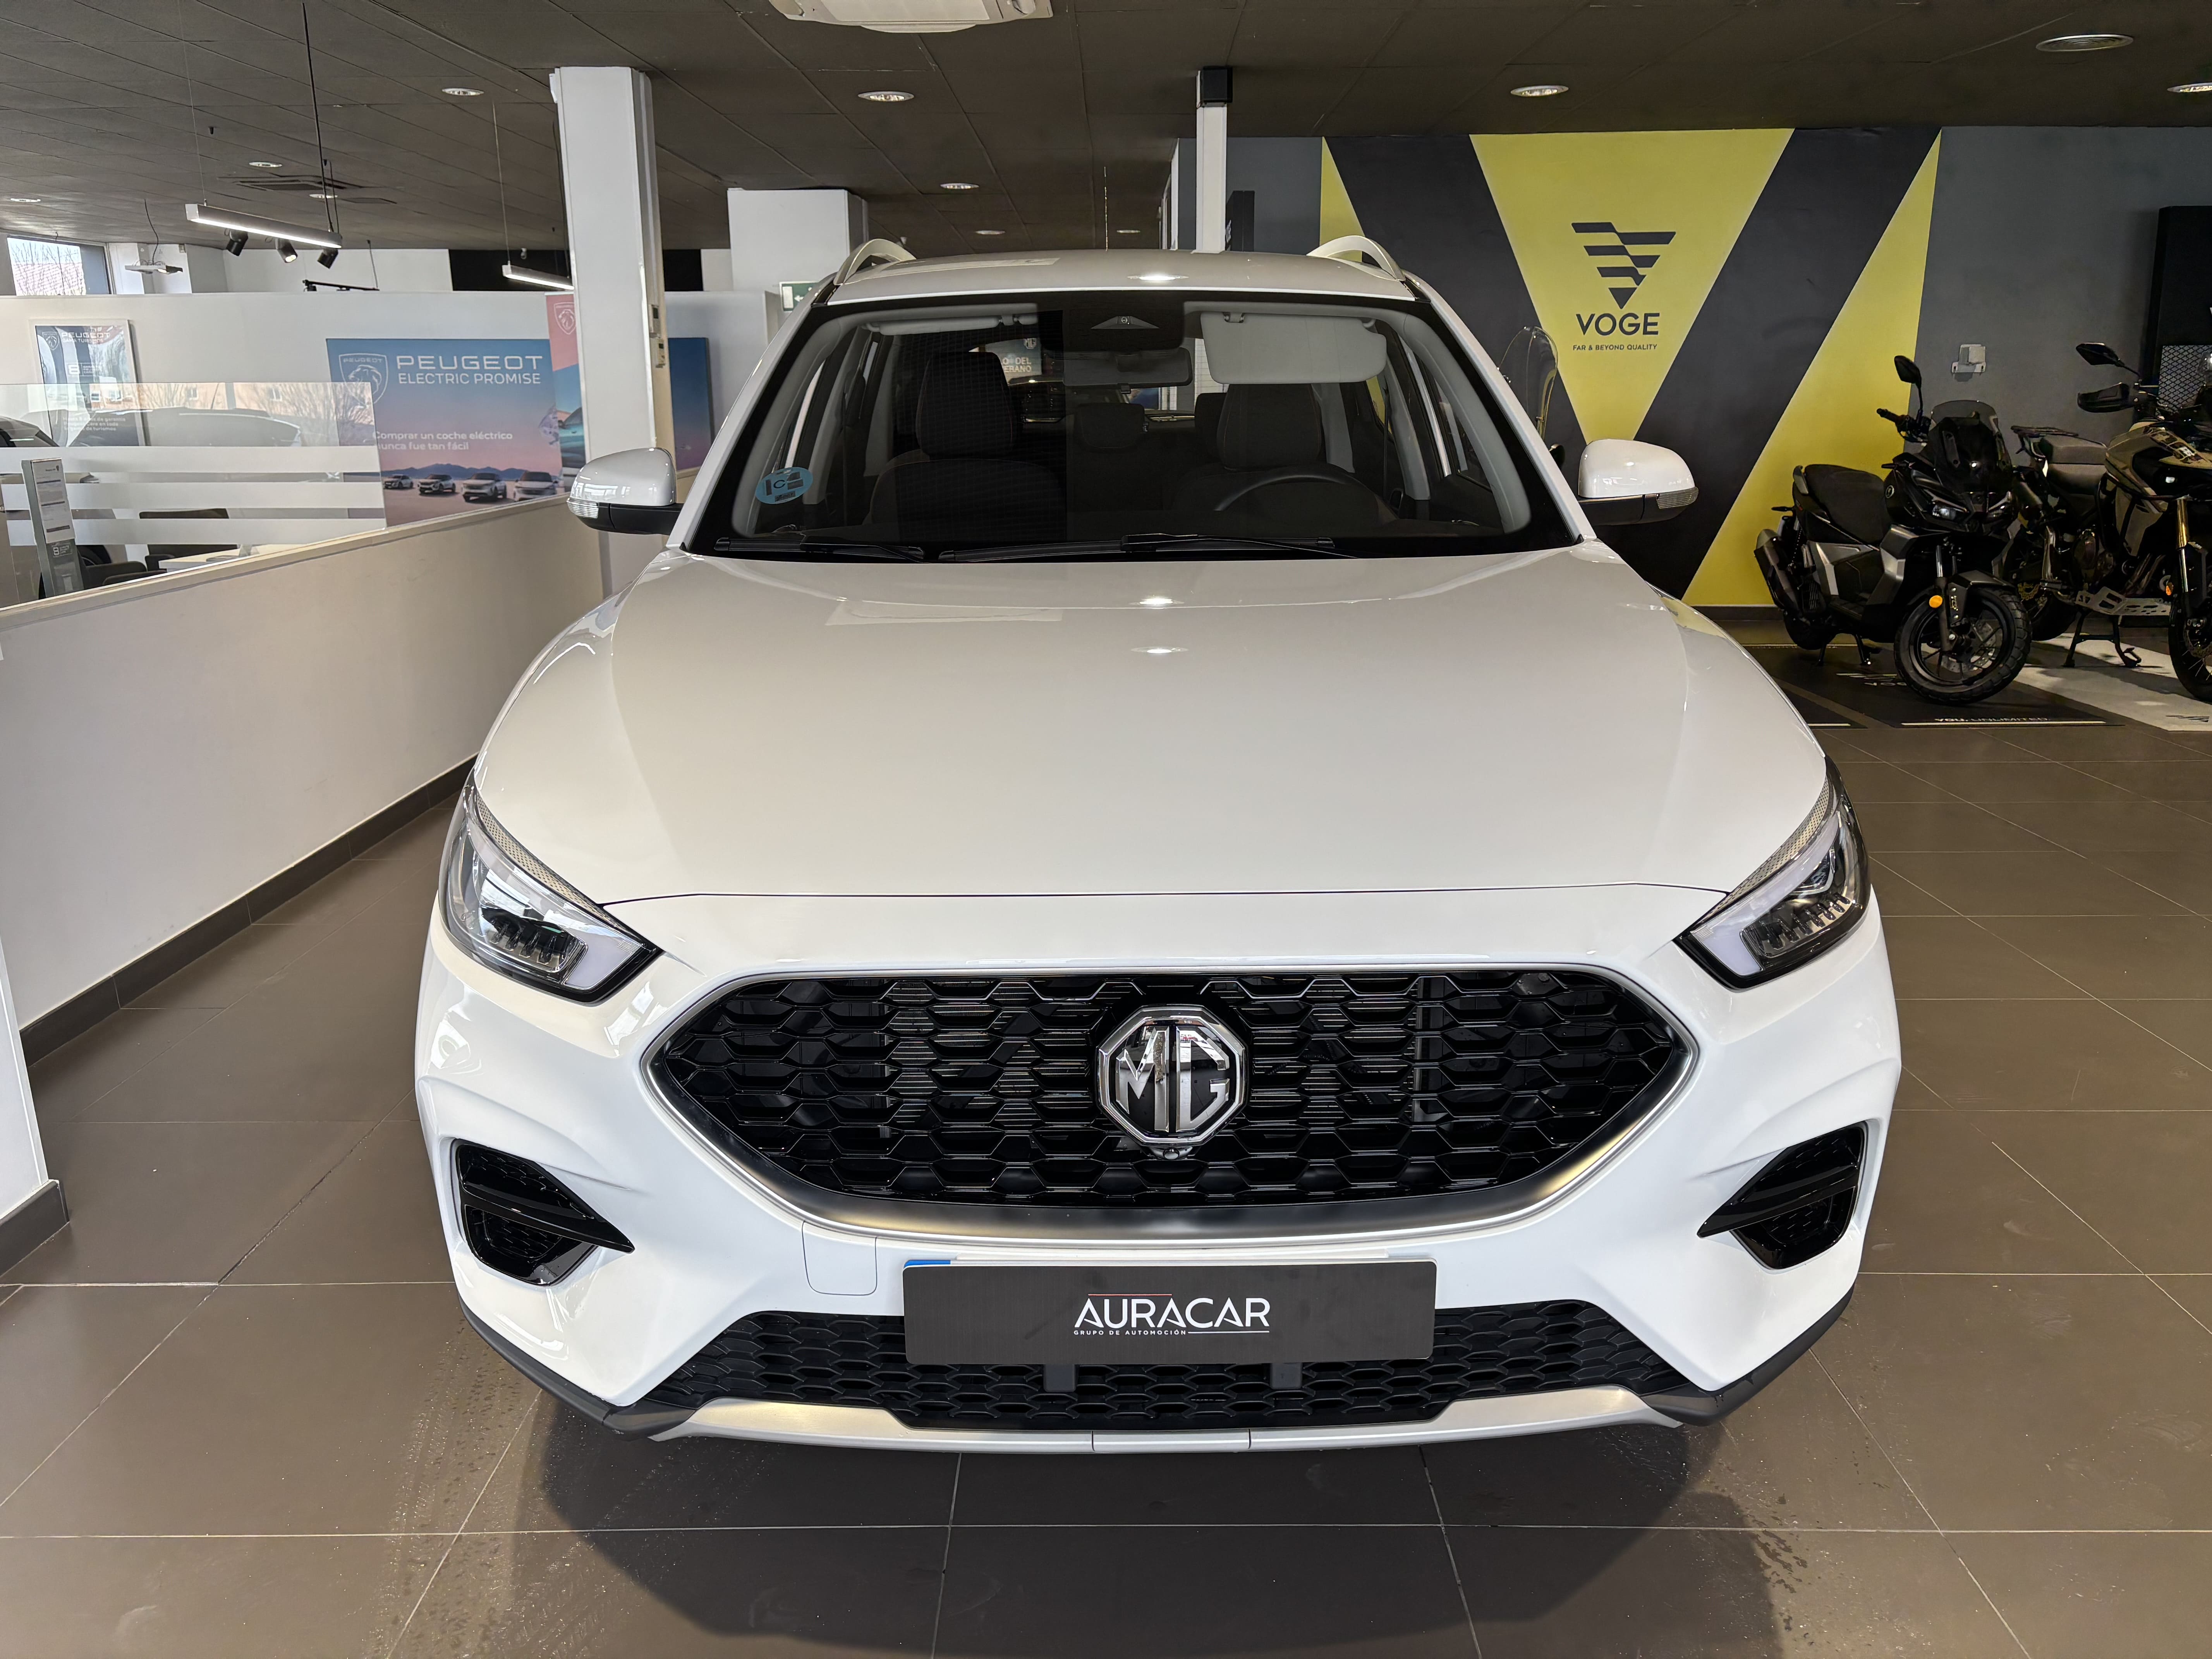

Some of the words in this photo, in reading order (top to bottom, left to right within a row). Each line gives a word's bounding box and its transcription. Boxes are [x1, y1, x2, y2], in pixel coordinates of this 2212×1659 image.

[1576, 313, 1660, 336] VOGE
[396, 355, 543, 370] PEUGEOT
[398, 373, 470, 384] ELECTRIC
[474, 373, 541, 384] PROMISE
[373, 431, 418, 441] Comprar
[436, 431, 466, 440] coche
[469, 431, 513, 440] eléctrico
[409, 441, 426, 450] fue
[447, 441, 469, 450] fácil
[1115, 1025, 1231, 1133] MG
[1074, 1297, 1271, 1329] AURACAR
